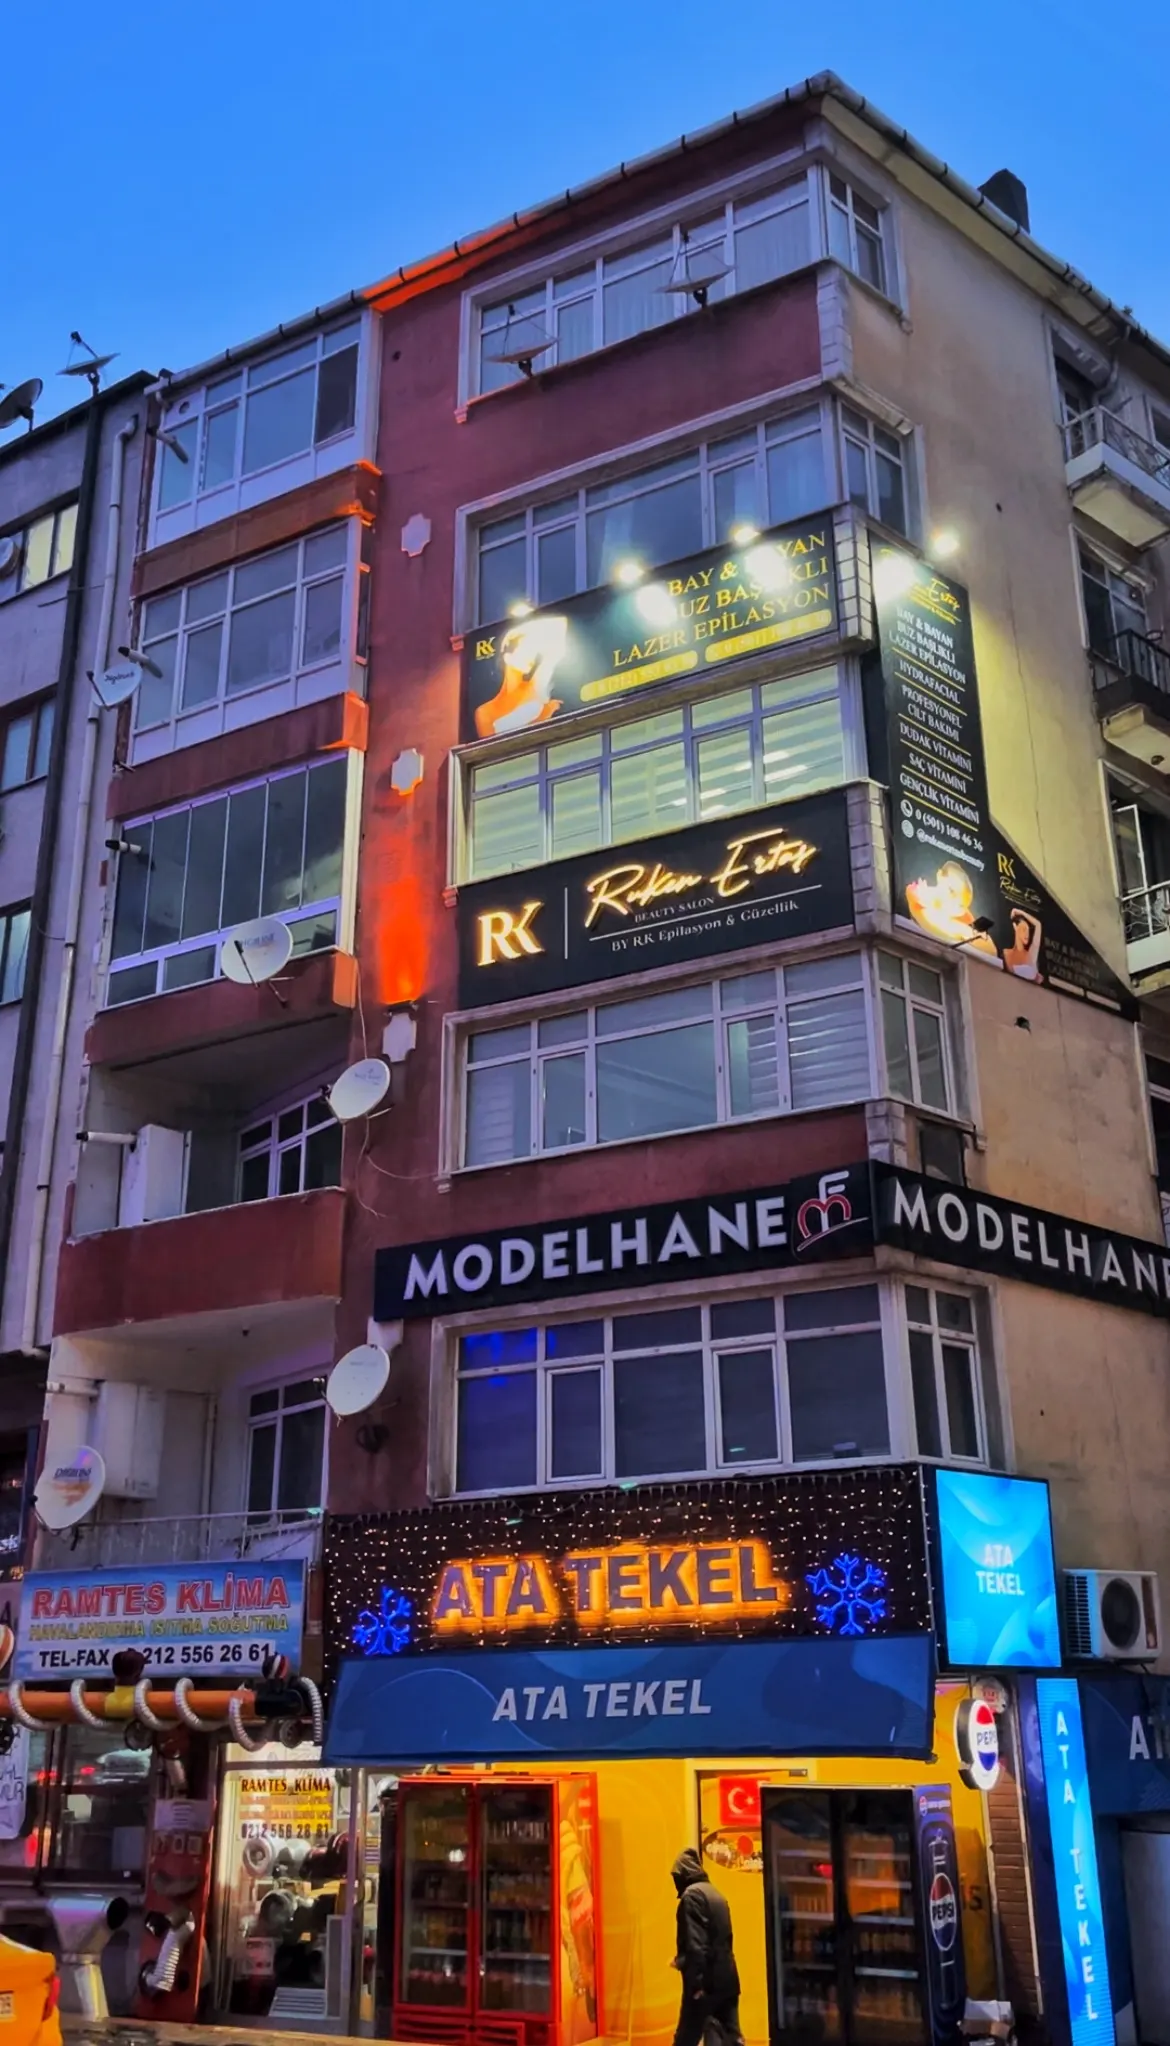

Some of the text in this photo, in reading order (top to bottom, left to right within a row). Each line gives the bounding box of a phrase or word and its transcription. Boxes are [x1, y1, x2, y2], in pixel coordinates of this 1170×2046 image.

[668, 568, 714, 597] BAY
[720, 561, 738, 580] &
[716, 557, 828, 608] BAŞKLI
[613, 629, 687, 667] LAZER
[694, 583, 830, 640] EPİLASYON
[889, 629, 918, 656] LAZER
[924, 622, 953, 649] BAYAN
[900, 659, 960, 704] HYDRAFACIAL
[902, 684, 963, 728] PROFESYONEL
[900, 722, 932, 750] DUDAK
[915, 809, 922, 820] 0
[923, 812, 945, 834] (501)
[611, 899, 800, 952] BY RK Epilasyon & Güzellik
[634, 896, 715, 923] BEAUTY SALON
[477, 901, 546, 967] RK
[403, 1195, 789, 1300] MODELHANE
[983, 1543, 1014, 1568] ATA
[31, 1571, 291, 1619] RAMTES KLİMA
[434, 1546, 778, 1619] ATA TEKEL
[976, 1570, 1025, 1596] TEKEL
[29, 1612, 289, 1642] HAVALANDIRMA ISITMA SOĞUTMA
[39, 1648, 109, 1667] TEL-FAX
[181, 1645, 213, 1664] 556
[220, 1644, 243, 1662] 26
[248, 1643, 270, 1661] 61
[493, 1679, 712, 1722] ATA TEKEL
[241, 1774, 331, 1792] RAMTES KLİMA
[1056, 1711, 1098, 2020] ATA TEKEL
[932, 1901, 955, 1921] PEPSI
